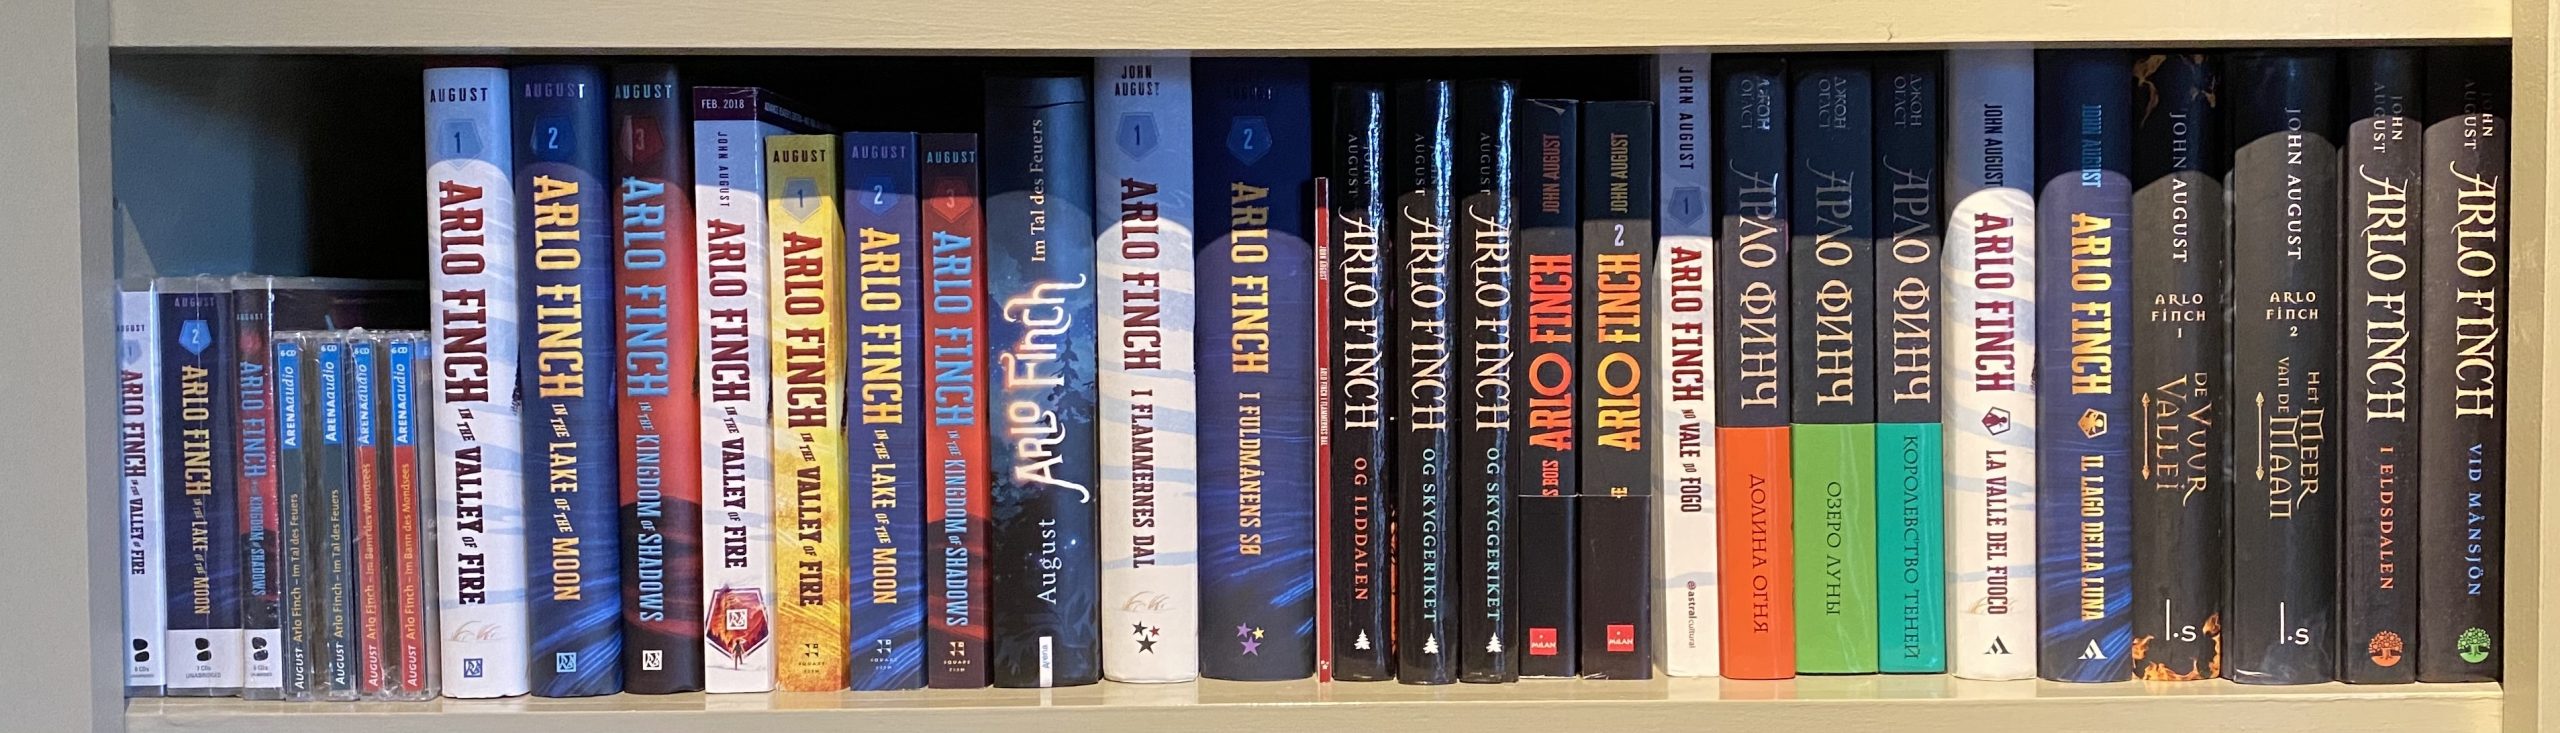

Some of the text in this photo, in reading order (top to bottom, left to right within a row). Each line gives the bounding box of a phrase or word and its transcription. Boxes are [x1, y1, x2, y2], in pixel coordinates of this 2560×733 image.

[548, 128, 558, 149] 2
[635, 128, 645, 150] 3
[701, 98, 746, 110] FEB. 2018
[1115, 82, 1160, 96] AUGUST
[1243, 128, 1253, 150] 2
[1678, 66, 1694, 105] JOHN
[1741, 79, 1753, 129] ОГАСТ
[1818, 78, 1831, 129] ОГАСТ
[1893, 76, 1906, 127] ОГАСТ
[1984, 104, 2003, 134] JOHN
[2082, 104, 2102, 135] JOHN
[718, 131, 730, 207] JOHN AUGUST
[873, 185, 884, 205] 2
[947, 189, 956, 208] 3
[1542, 182, 1561, 214] JOHN
[1610, 133, 1628, 213] JOHN AUGUST
[2172, 178, 2187, 262] AUGUST
[2287, 174, 2302, 260] AUGUST
[2359, 164, 2408, 281] ARLO
[174, 297, 215, 307] AUGUST
[192, 328, 199, 344] 2
[1528, 253, 1574, 452] ARLO FINCH
[1596, 253, 1642, 452] ARLO FINCH
[1740, 281, 1778, 410] ФИНЧ
[1816, 279, 1854, 406] ФИНЧ
[1893, 277, 1931, 404] ФИНЧ
[2155, 293, 2204, 307] ARLO
[2269, 291, 2316, 305] ARLO
[2366, 290, 2410, 423] FINCH
[439, 179, 489, 605] ARLO FINCH THE VALLEY FIRE
[533, 175, 584, 601] ARLO FINCH LAKE MOON
[622, 176, 669, 623] ARLO FINCH KINGDOM SHADOWS
[783, 231, 828, 607] ARLO FINCH THE VALLEY FIRE
[859, 228, 902, 605] ARLO FINCH LAKE MOON
[1030, 118, 1062, 605] August Tal des Feuers
[1671, 246, 1704, 513] ARLO FINCH NO VALE DO FOGO
[2277, 356, 2290, 413] VAN DE
[2450, 160, 2498, 596] ARLO VID MÅNSJÖN
[121, 370, 145, 575] ARLO VALLEY FIRE
[181, 365, 212, 614] ARLO FINCH LAKE MOON
[932, 231, 975, 627] ARLO FINCH KINGDOM SHADOWS
[1131, 389, 1155, 569] I FLAMMERNES DAL
[1239, 391, 1265, 556] I FULDMÅNENS SØ
[1344, 316, 1383, 600] FINCH OG ILDDALEN
[1411, 317, 1450, 622] FINCH OG SKYGGERIKET
[1475, 316, 1515, 622] FINCH OG SKYGGERIKET
[1542, 459, 1560, 486] BOIS
[2156, 374, 2187, 492] VALLEI
[2184, 372, 2213, 507] DE VUUR
[2269, 415, 2300, 520] MAAN
[2297, 407, 2325, 510] MEER
[250, 496, 264, 541] KINGDOM
[721, 437, 748, 569] VALLEY FIRE
[1749, 474, 1769, 633] ДОЛИНА ОГНЯ
[1826, 481, 1842, 616] ОЗЕРО ЛУНЫ
[1903, 435, 1921, 659] КОРОЛЕВСТВО ТЕНЕЙ
[1985, 449, 2008, 615] LA VALLE DEL FUOCO
[2081, 455, 2105, 622] IL LAGO DELLA LUNA
[2380, 464, 2394, 590] ELDSDALEN
[251, 548, 266, 596] SHADOWS
[290, 494, 305, 689] AUGUST Arlo Tal Feuers
[331, 490, 346, 684] AUGUST Arlo Tal Feuers
[366, 615, 377, 639] Arlo
[401, 464, 418, 686] AUGUST Arlo Bann Mondsees
[368, 645, 378, 686] AUGUST
